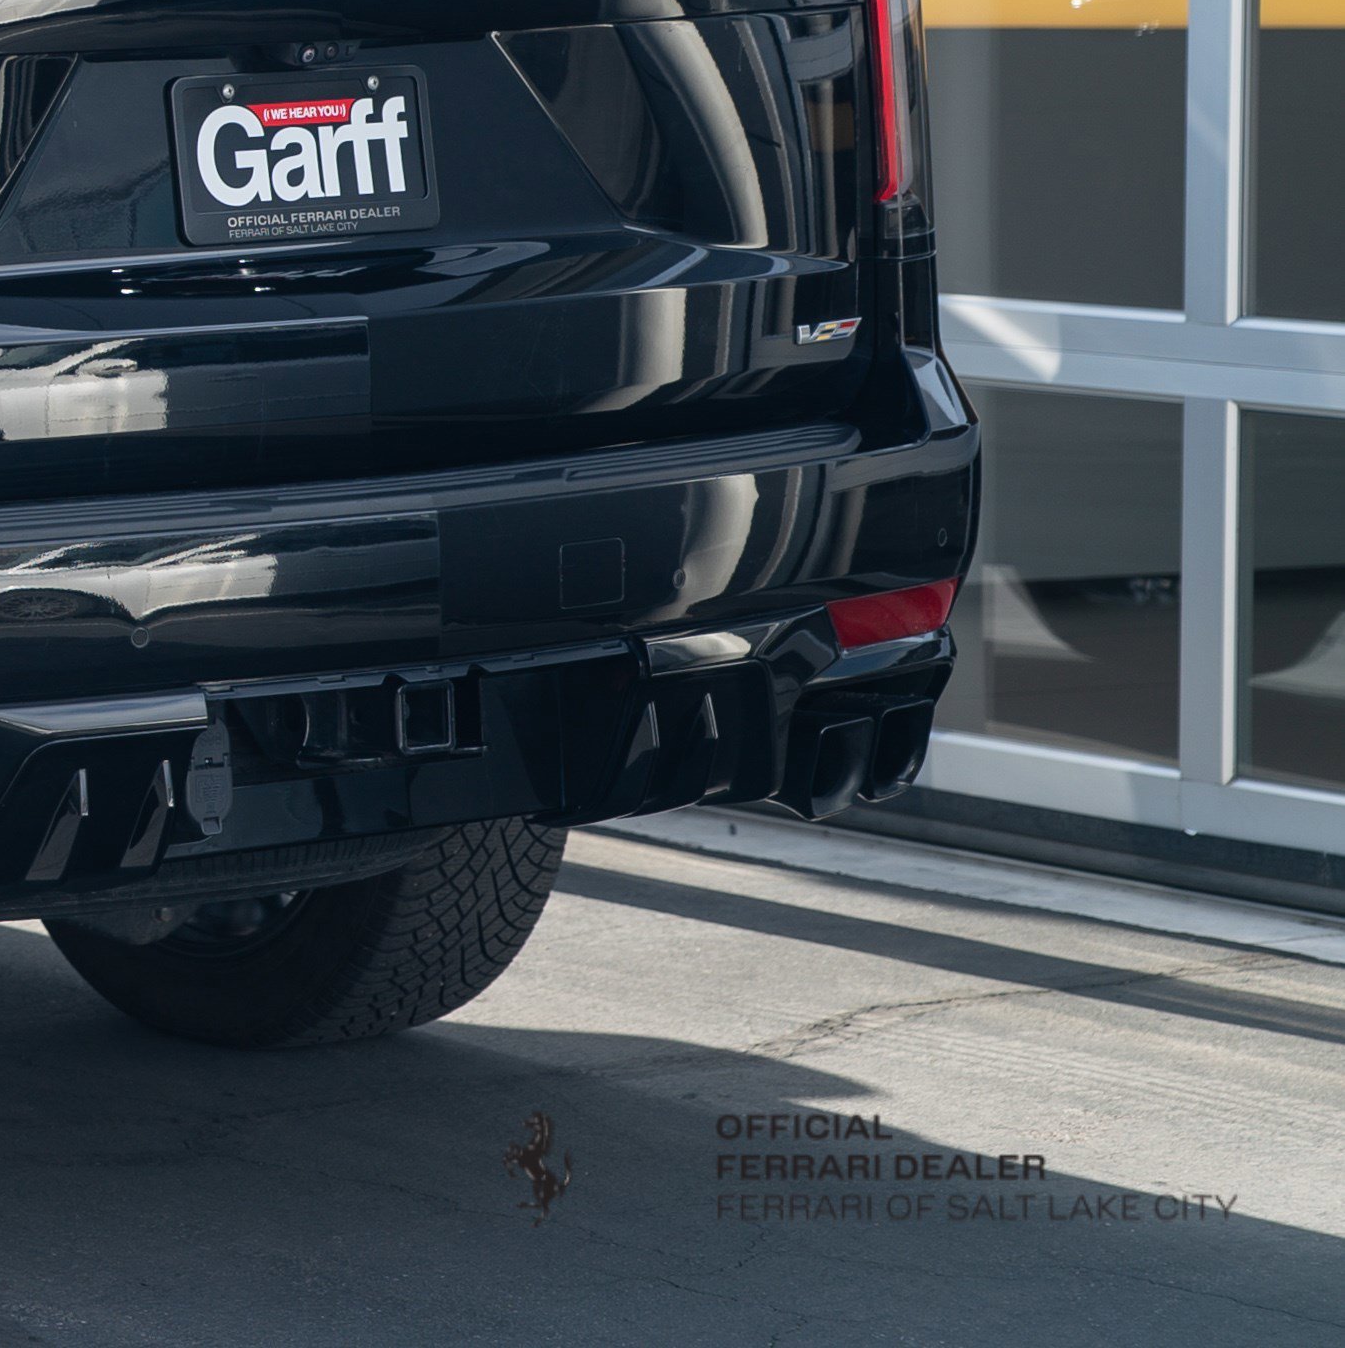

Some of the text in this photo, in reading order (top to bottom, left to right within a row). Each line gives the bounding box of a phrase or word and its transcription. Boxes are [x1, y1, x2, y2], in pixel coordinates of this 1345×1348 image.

[289, 108, 317, 119] HEAR
[316, 106, 339, 118] YOU
[197, 96, 408, 207] Garff
[227, 206, 401, 228] OFFICIAL FERRARI DEALER
[229, 221, 358, 239] FERRARI OF SALT LAKE CITY
